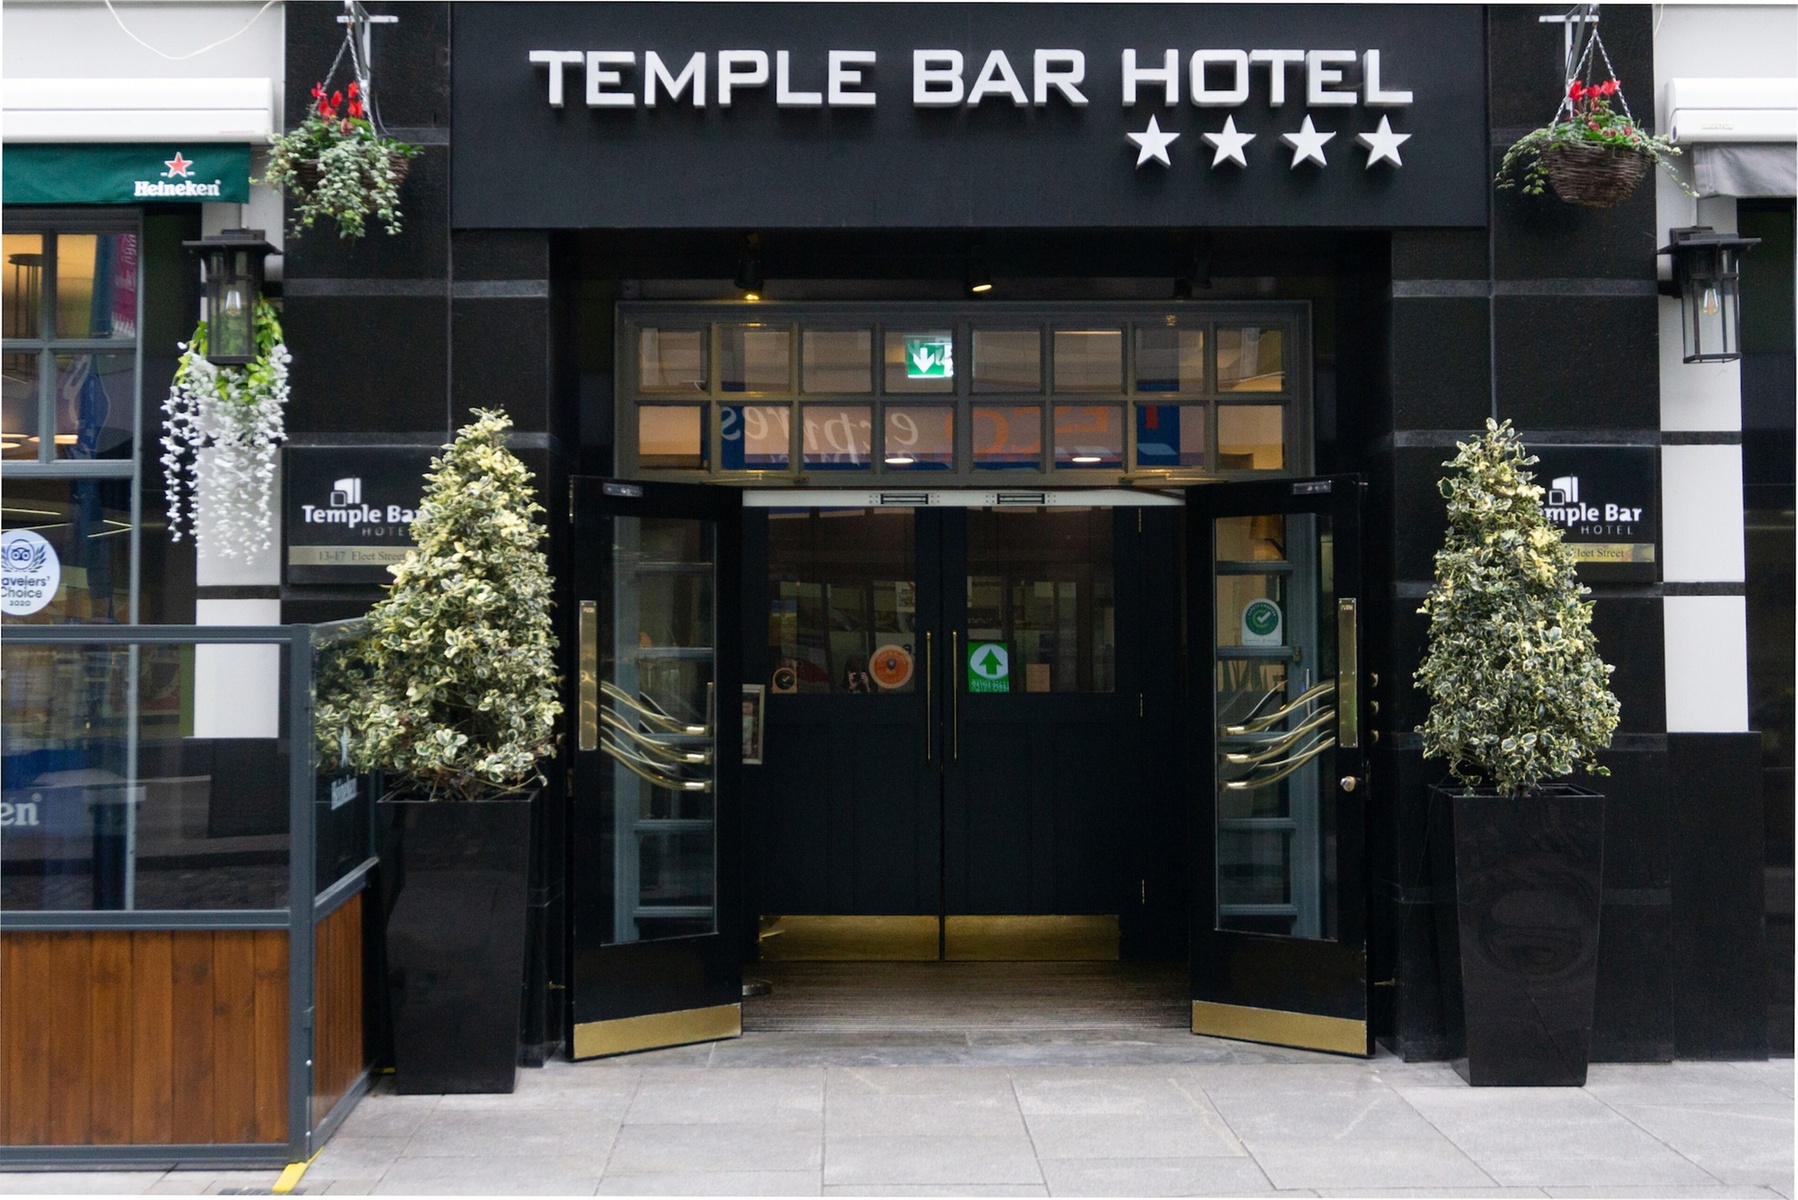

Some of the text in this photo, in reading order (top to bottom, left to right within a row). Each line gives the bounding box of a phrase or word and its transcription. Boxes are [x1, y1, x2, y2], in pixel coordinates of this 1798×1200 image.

[529, 48, 1413, 108] TEMPLE BAR HOTEL
[134, 180, 220, 197] Heineken
[302, 504, 382, 529] Temple
[1605, 503, 1642, 522] Bar
[362, 527, 413, 537] HOTE
[1581, 525, 1634, 535] HOTEL
[319, 551, 405, 561] 13-17 Fleet Street
[1597, 548, 1624, 558] Street
